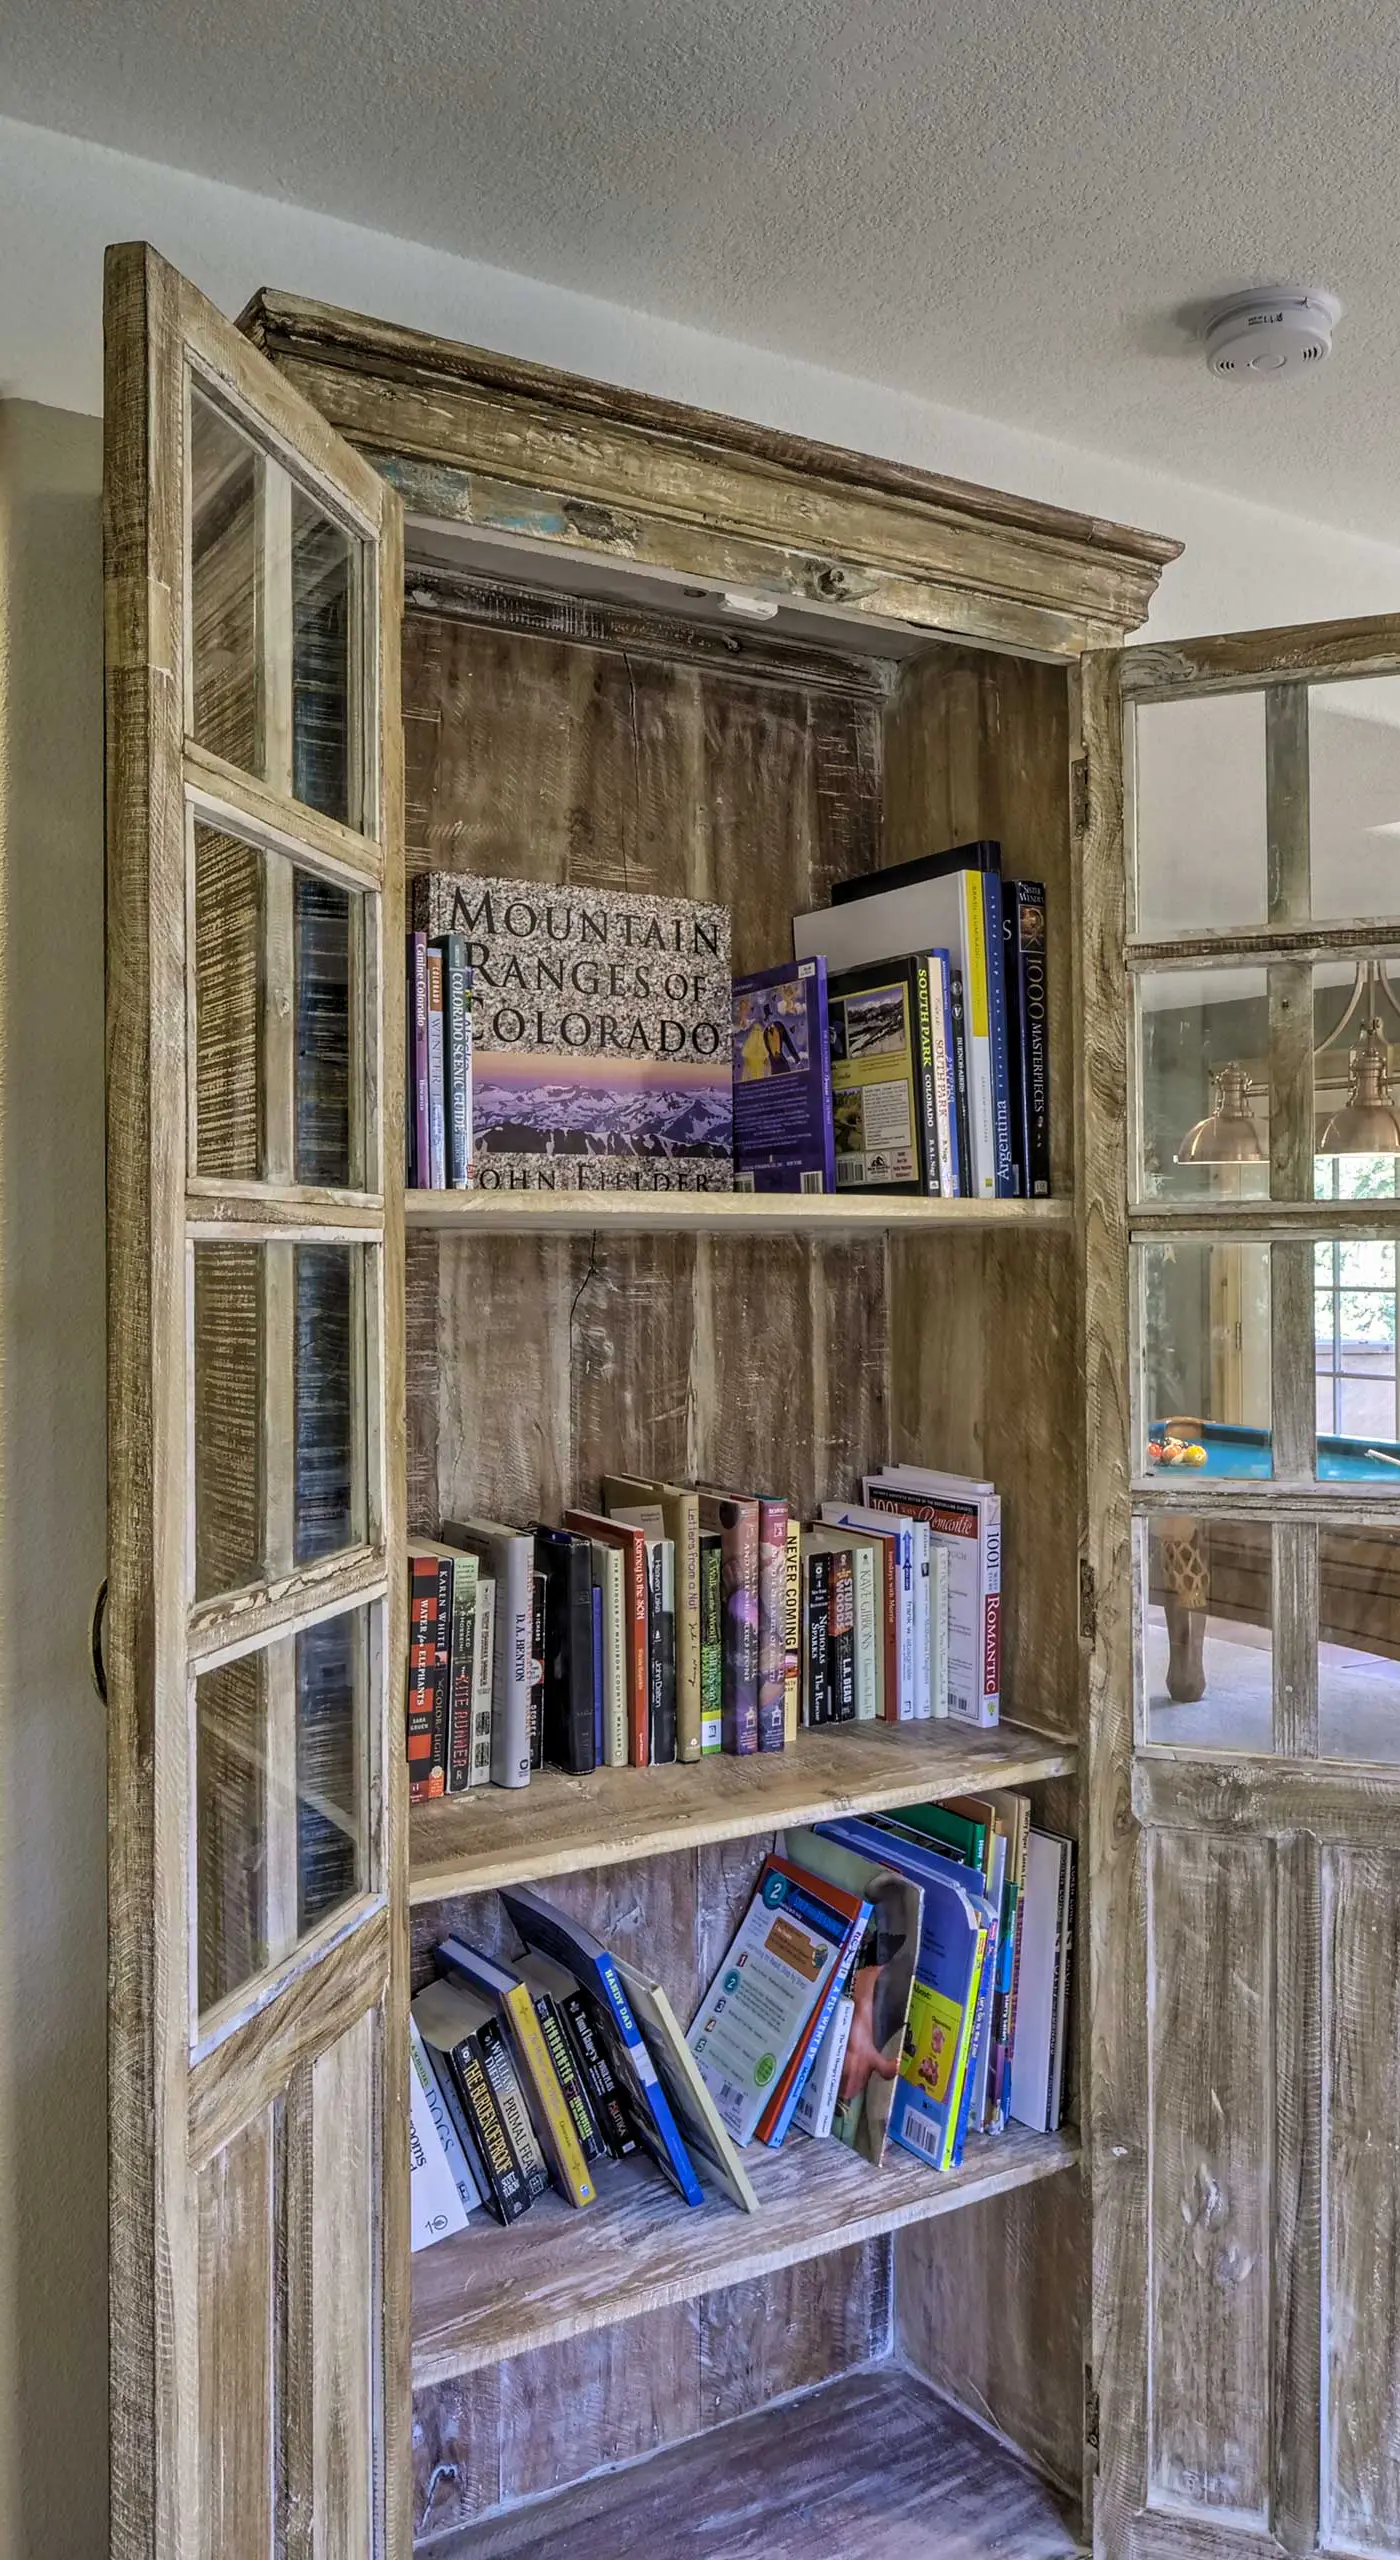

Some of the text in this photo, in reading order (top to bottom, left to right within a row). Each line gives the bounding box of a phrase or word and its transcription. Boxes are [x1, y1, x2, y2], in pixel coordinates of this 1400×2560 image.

[450, 886, 719, 957] MOUNTAIN
[416, 943, 427, 1027] Canine Colorado
[432, 966, 441, 1004] COLORADO
[466, 941, 706, 1003] RANGES OF
[917, 969, 933, 1067] SOUTH PARK
[1026, 959, 1045, 1113] 1000 MASTERPIECES
[452, 973, 466, 1132] COLORADO SCENIC GUIDE
[935, 1039, 948, 1117] SOUTH PARK
[924, 1074, 936, 1127] COLORADO
[995, 1100, 1012, 1180] Argentina
[474, 1167, 556, 1191] OHN
[634, 1537, 644, 1573] Journey
[688, 1508, 699, 1611] Letters from a Nut
[986, 1531, 1000, 1570] 1001
[636, 1573, 643, 1583] to
[636, 1584, 644, 1598] the
[654, 1559, 662, 1613] Heaven Lake
[708, 1566, 717, 1589] Walk
[785, 1536, 798, 1646] NEVER COMING
[844, 1577, 853, 1627] STUART
[419, 1599, 429, 1633] WATER
[437, 1570, 449, 1649] KAREN WHITE
[836, 1579, 845, 1631] WOODS
[516, 1626, 525, 1636] A.
[811, 1622, 820, 1659] SPARKS
[818, 1614, 828, 1664] NICHOLAS
[985, 1595, 1000, 1692] ROMANTIC
[416, 1650, 427, 1706] ELEPHANTS
[515, 1639, 525, 1682] BENTON
[843, 1658, 852, 1677] L.A.
[814, 1671, 825, 1721] The Rescue
[843, 1678, 852, 1703] DEAD
[433, 1689, 444, 1764] COLOR LIGHT
[453, 1676, 469, 1768] KITE RUNNER
[770, 1882, 782, 1899] 2
[604, 1969, 633, 2030] HANDY DAD
[728, 1977, 737, 1989] 2
[825, 1995, 837, 2013] FLY
[807, 2046, 818, 2060] BY
[814, 2015, 830, 2047] WENT
[484, 2056, 503, 2092] DIEHL
[491, 2040, 516, 2094] WILLIAM
[463, 2058, 514, 2175] THE BURDEN OF PROOF
[503, 2096, 539, 2177] PRIMAL FEAR
